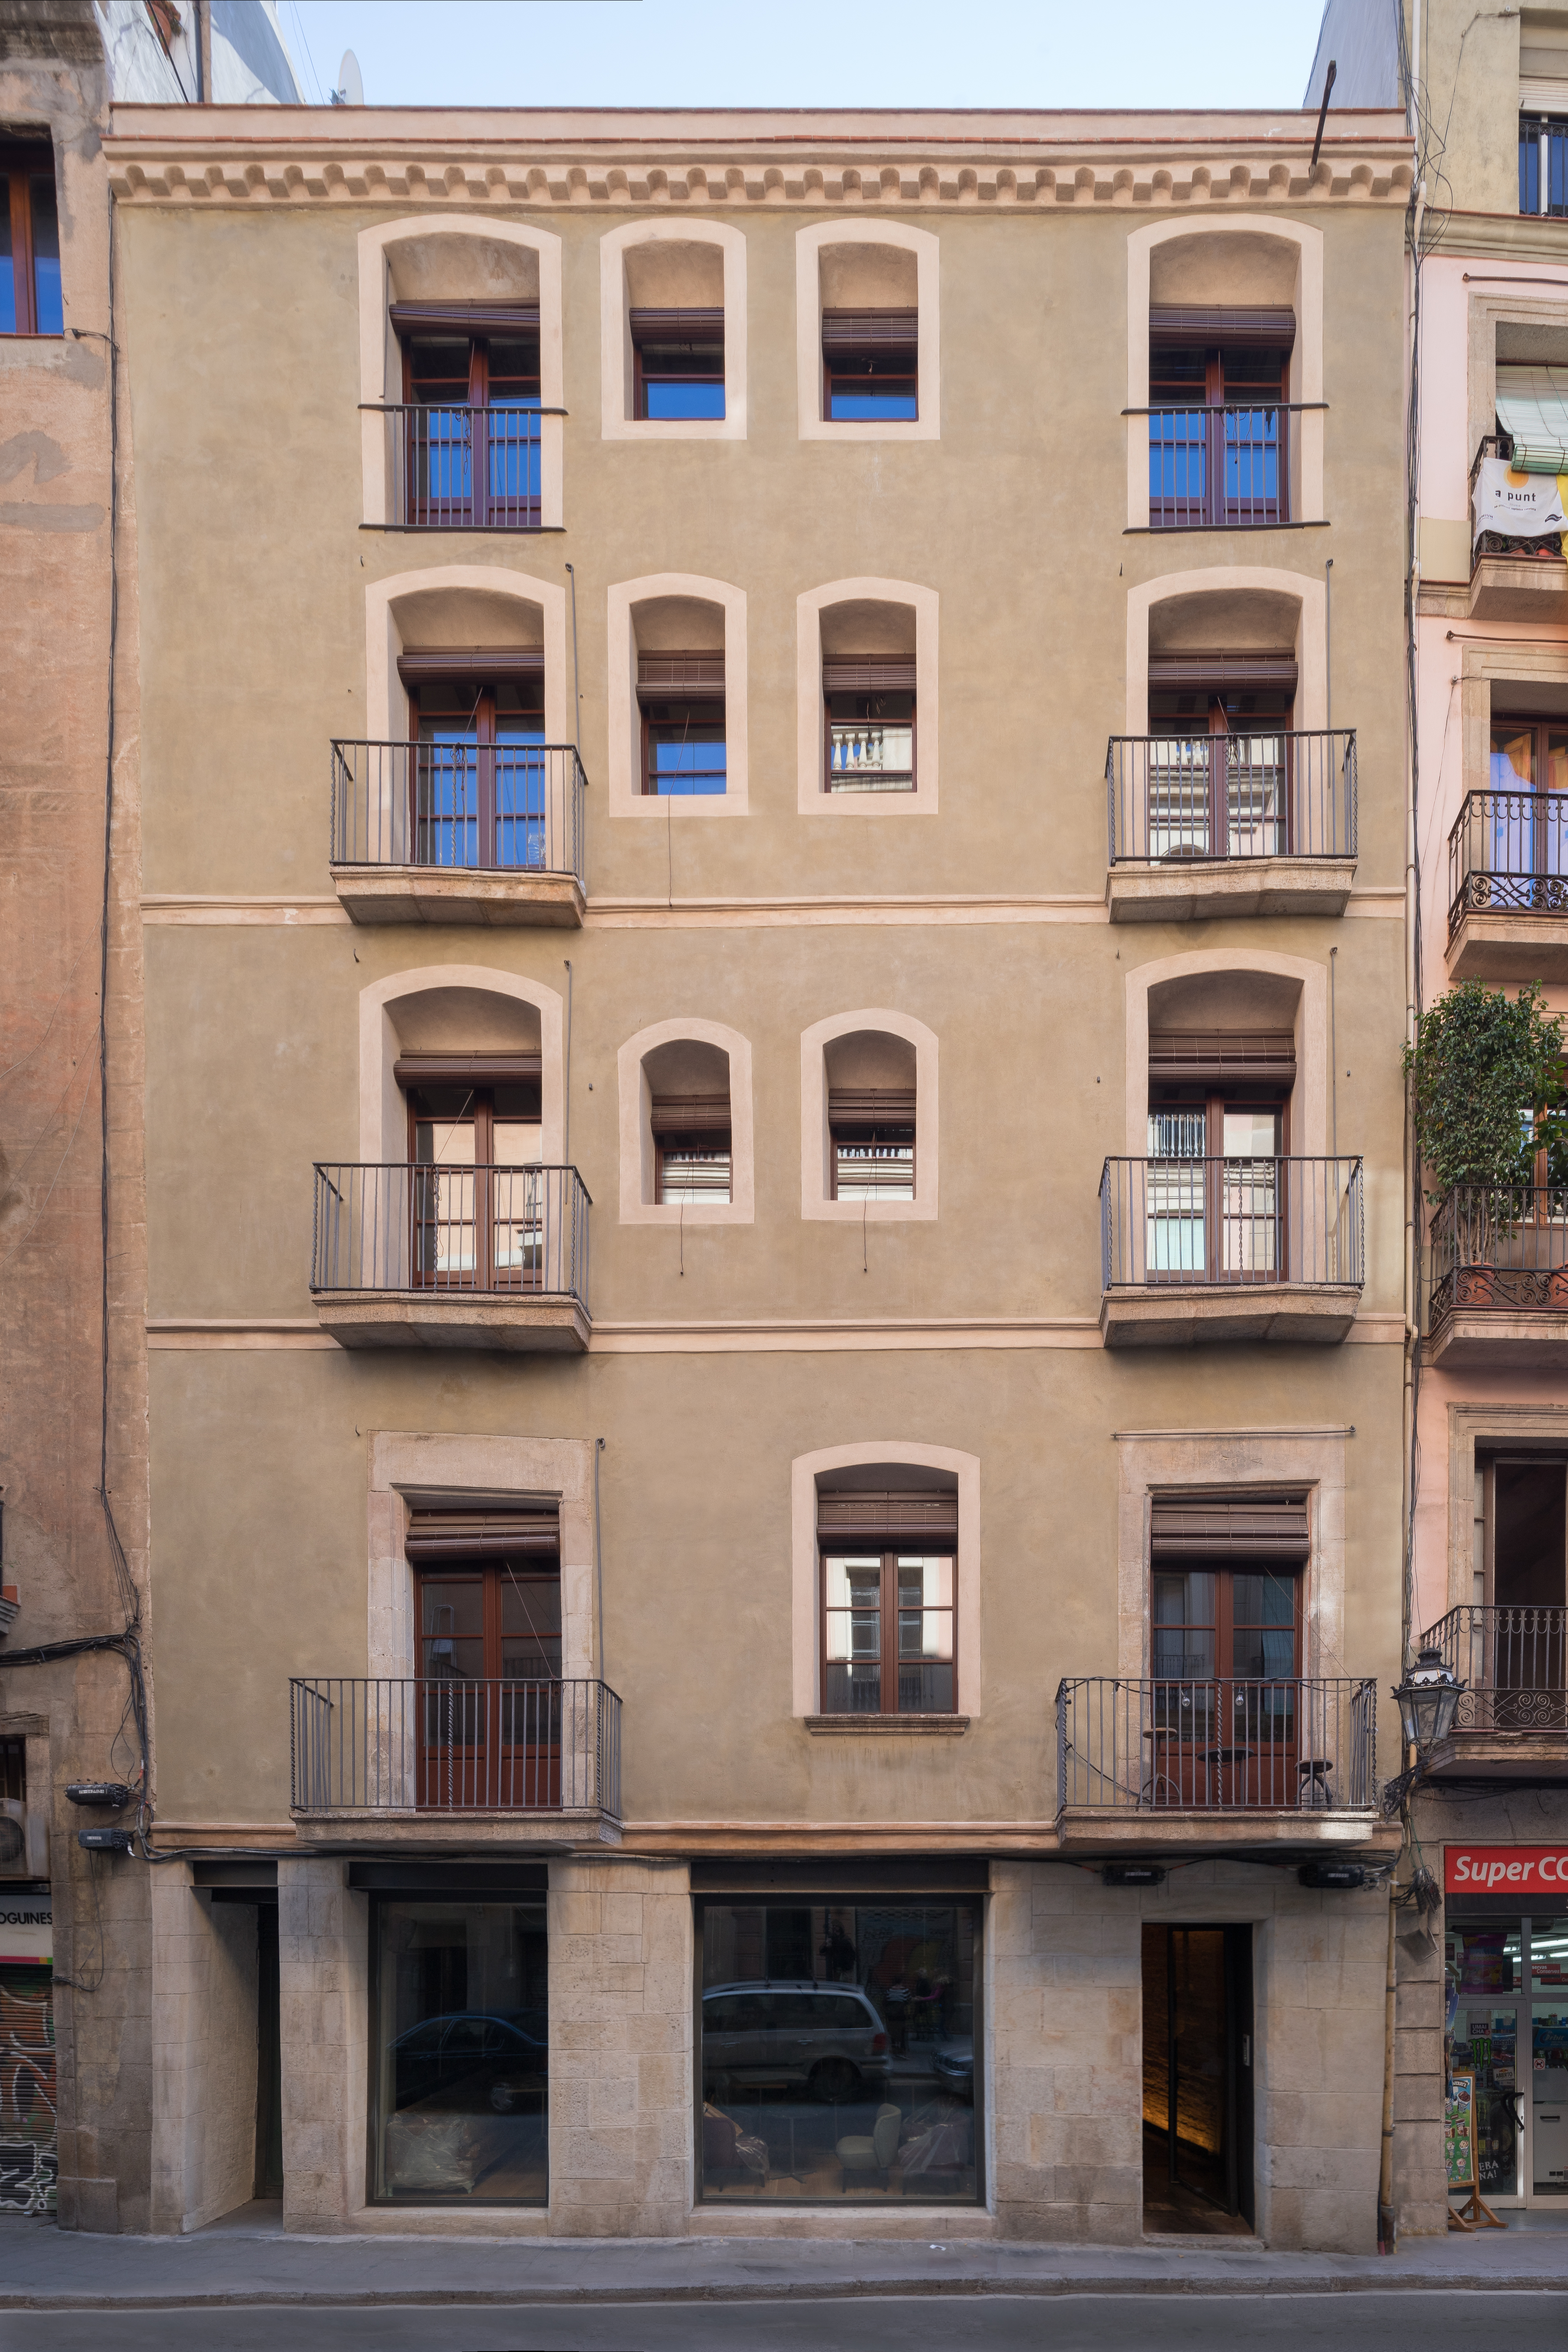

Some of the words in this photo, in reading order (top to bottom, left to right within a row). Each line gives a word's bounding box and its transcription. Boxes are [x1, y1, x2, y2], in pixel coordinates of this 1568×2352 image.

[1508, 492, 1536, 502] punt
[1454, 1856, 1535, 1887] Super
[1538, 1856, 1568, 1881] CO
[1479, 2160, 1499, 2171] EBA
[1479, 2169, 1497, 2181] NA!
